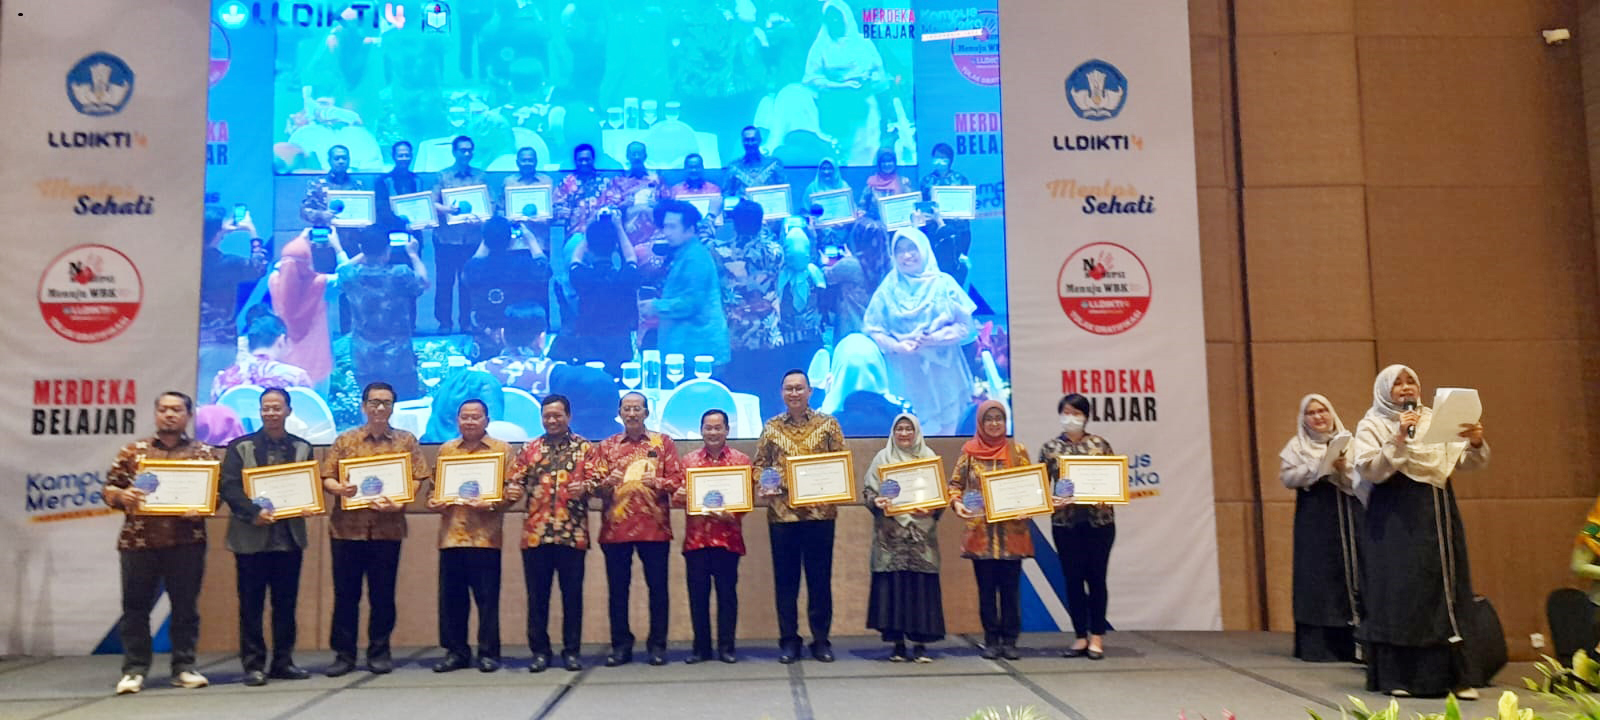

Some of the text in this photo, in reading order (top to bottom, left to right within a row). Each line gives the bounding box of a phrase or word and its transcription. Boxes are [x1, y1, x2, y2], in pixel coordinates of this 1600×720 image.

[863, 8, 916, 23] MERDEKA
[863, 24, 916, 39] BELAJAR
[955, 113, 999, 132] MERD
[956, 135, 999, 155] BELA
[73, 195, 155, 215] Sehati
[1082, 195, 1156, 214] Sehati
[1104, 284, 1129, 293] WBK
[1061, 369, 1156, 394] MERDEKA
[34, 379, 137, 405] MERDEKA
[1092, 397, 1158, 422] LAJAR
[32, 408, 135, 435] BELAJAR
[26, 471, 106, 495] Kampu
[26, 490, 103, 511] Merde
